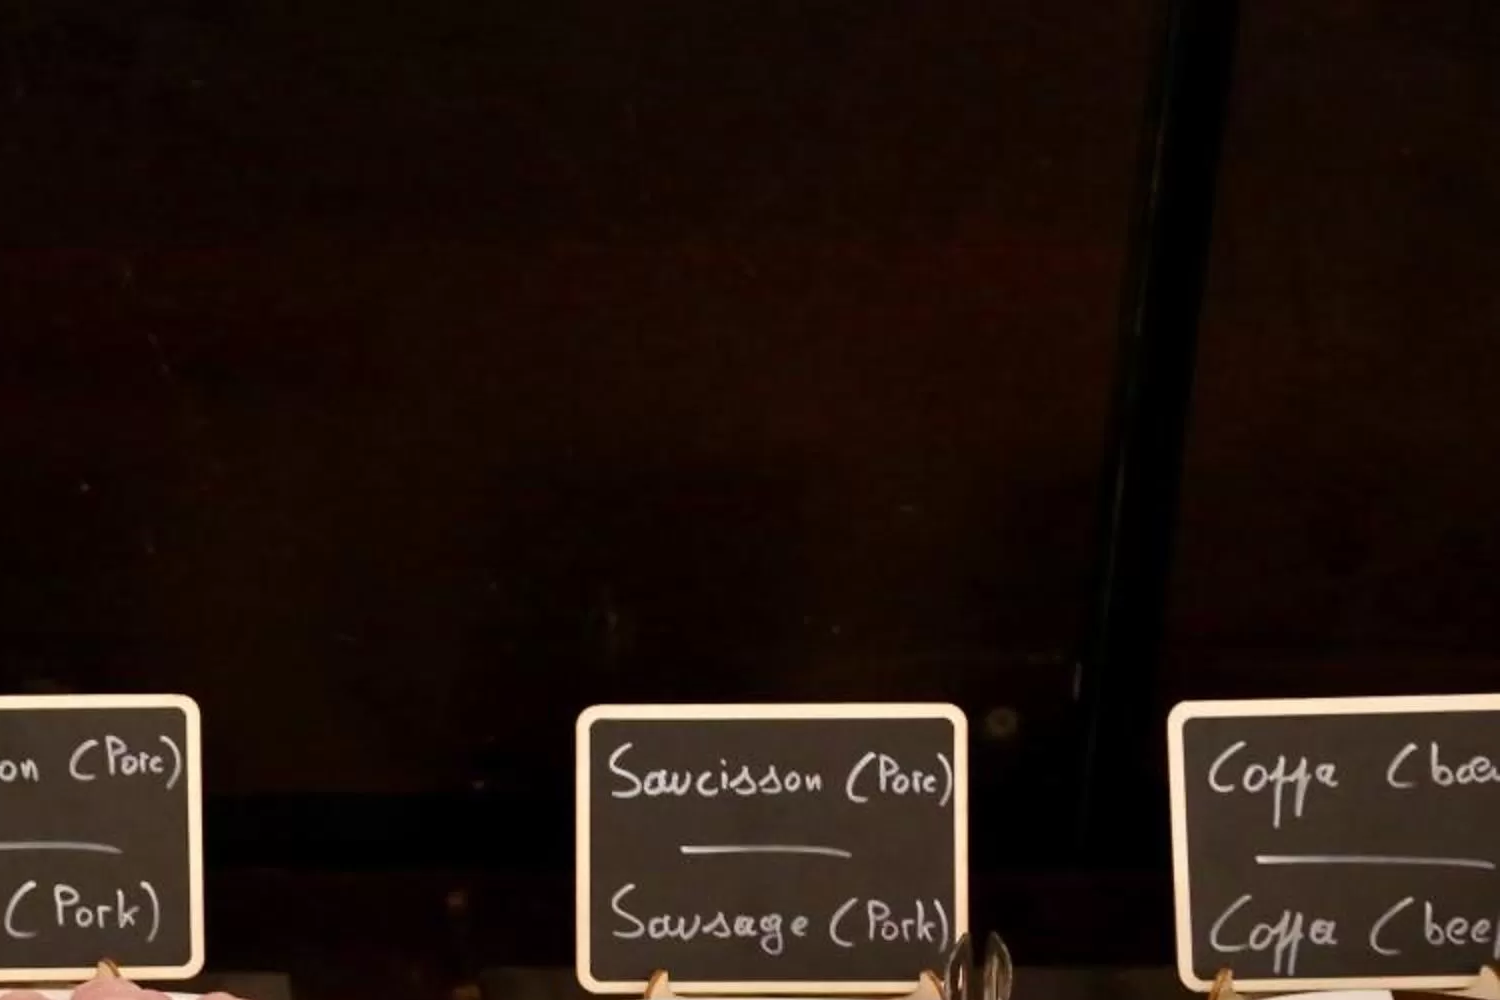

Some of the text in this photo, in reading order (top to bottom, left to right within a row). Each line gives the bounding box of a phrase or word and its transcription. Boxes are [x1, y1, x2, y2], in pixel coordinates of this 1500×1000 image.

[608, 741, 822, 799] Saucisson
[3, 879, 160, 943] (Pork)
[611, 882, 949, 955] Sausage (Pork)
